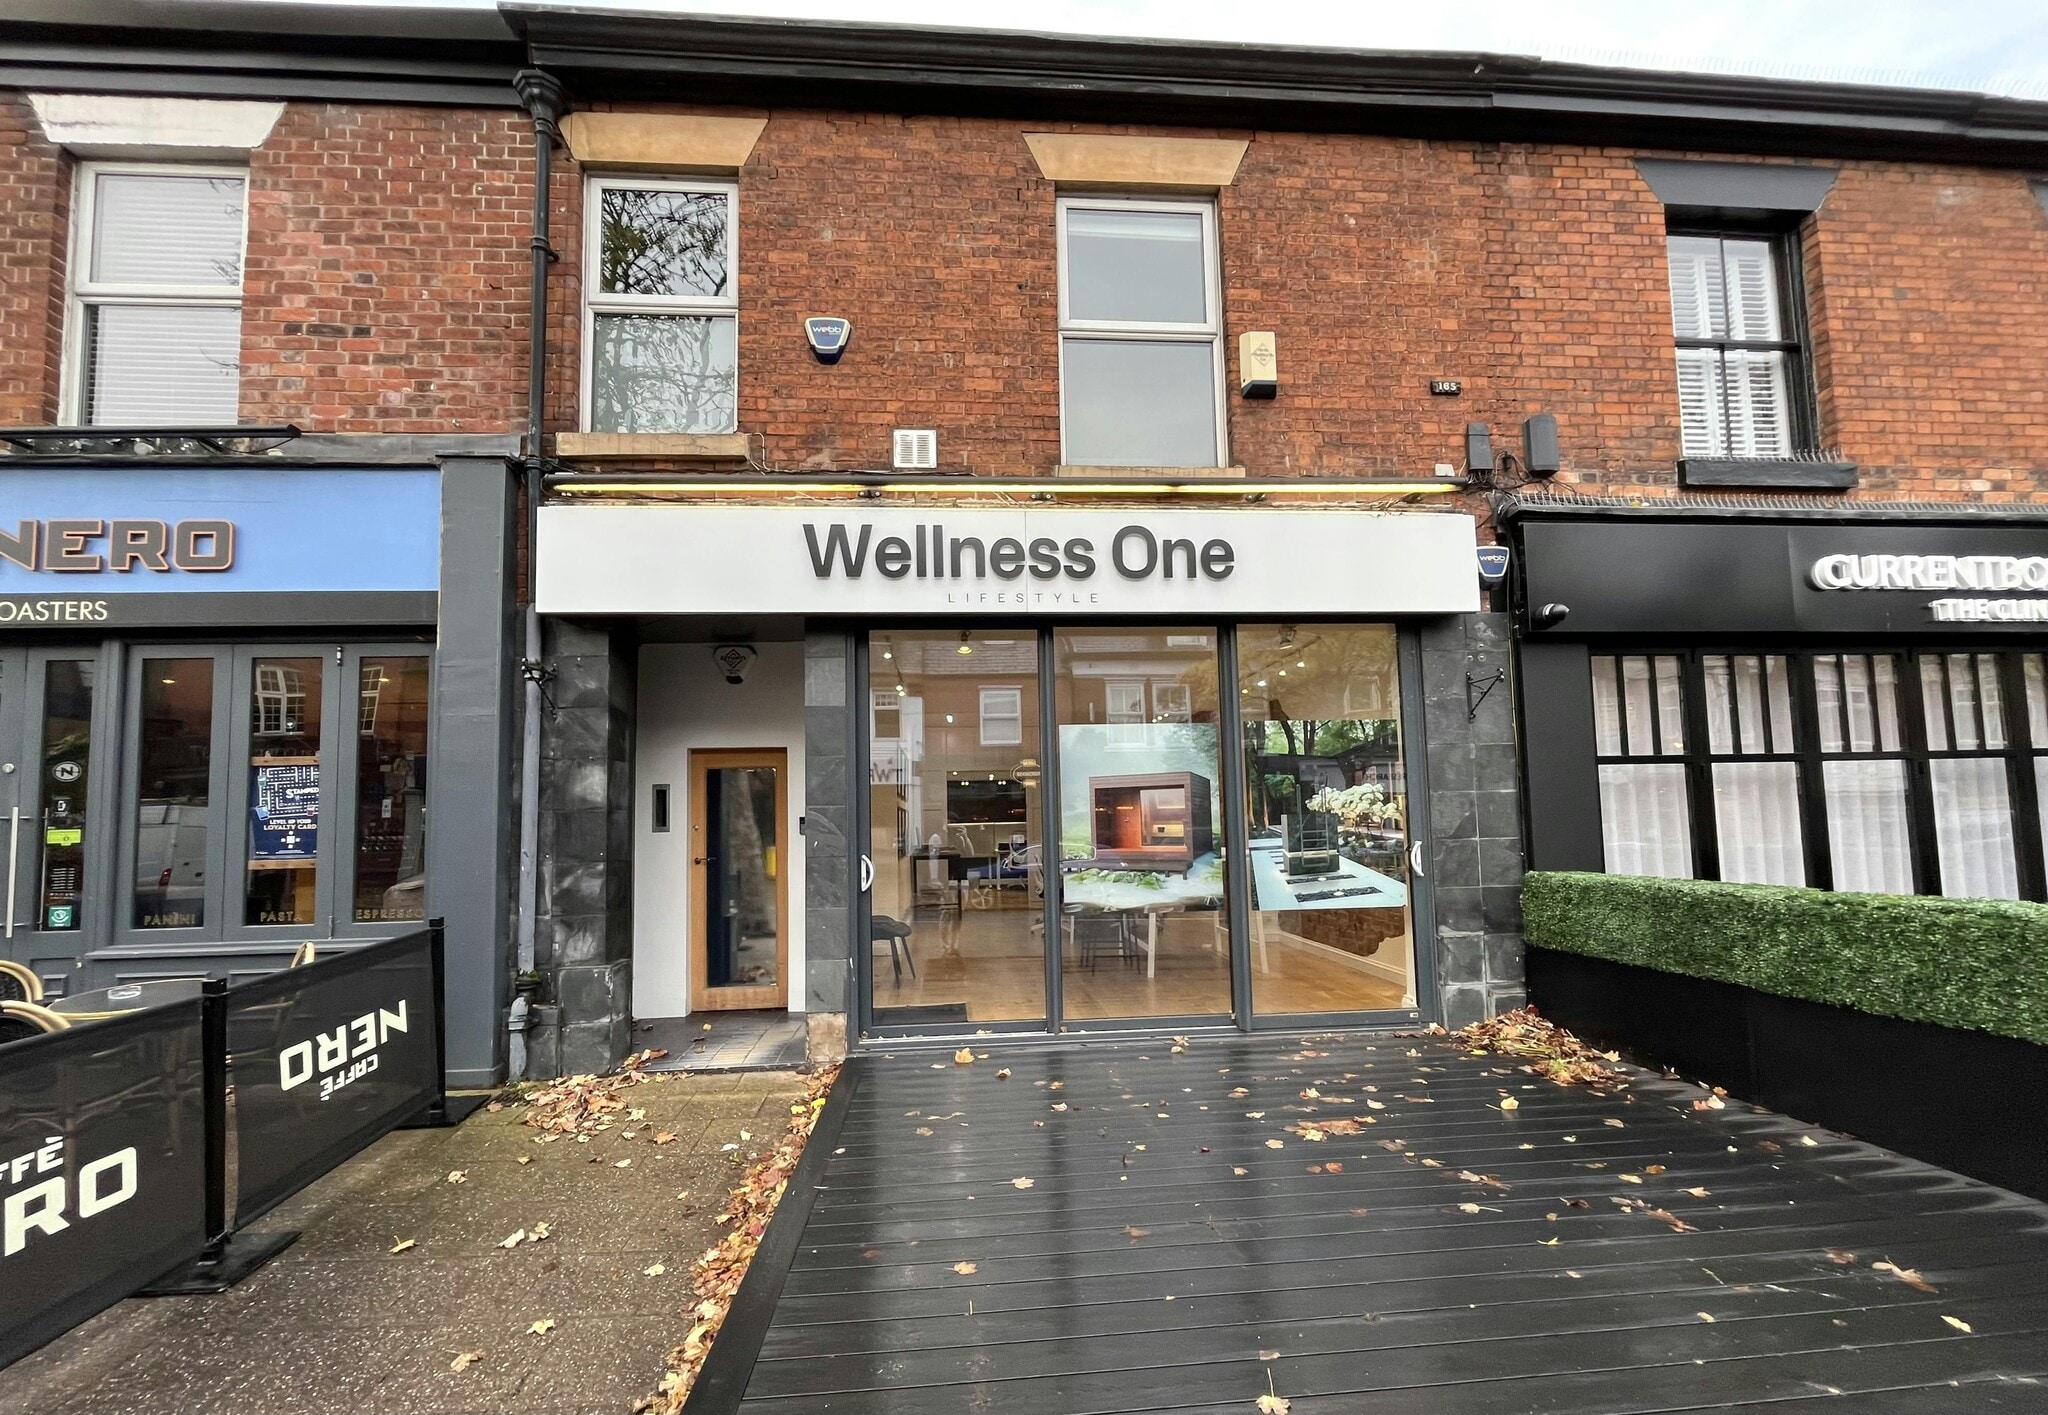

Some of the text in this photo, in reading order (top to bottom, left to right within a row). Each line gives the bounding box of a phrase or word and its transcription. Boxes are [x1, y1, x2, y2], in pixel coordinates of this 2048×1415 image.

[1438, 381, 1457, 391] 165
[0, 519, 235, 571] NERO
[802, 523, 1236, 580] Wellness One
[947, 592, 1099, 604] LIFESTYLE
[0, 600, 108, 622] OASTERS
[1929, 599, 1989, 621] THE
[144, 913, 196, 926] PANINI
[260, 911, 303, 922] PASTA
[355, 908, 424, 920] ESPRESSO
[279, 999, 408, 1091] NERO
[320, 1053, 379, 1101] CAFFÈ
[4, 1146, 138, 1257] RO
